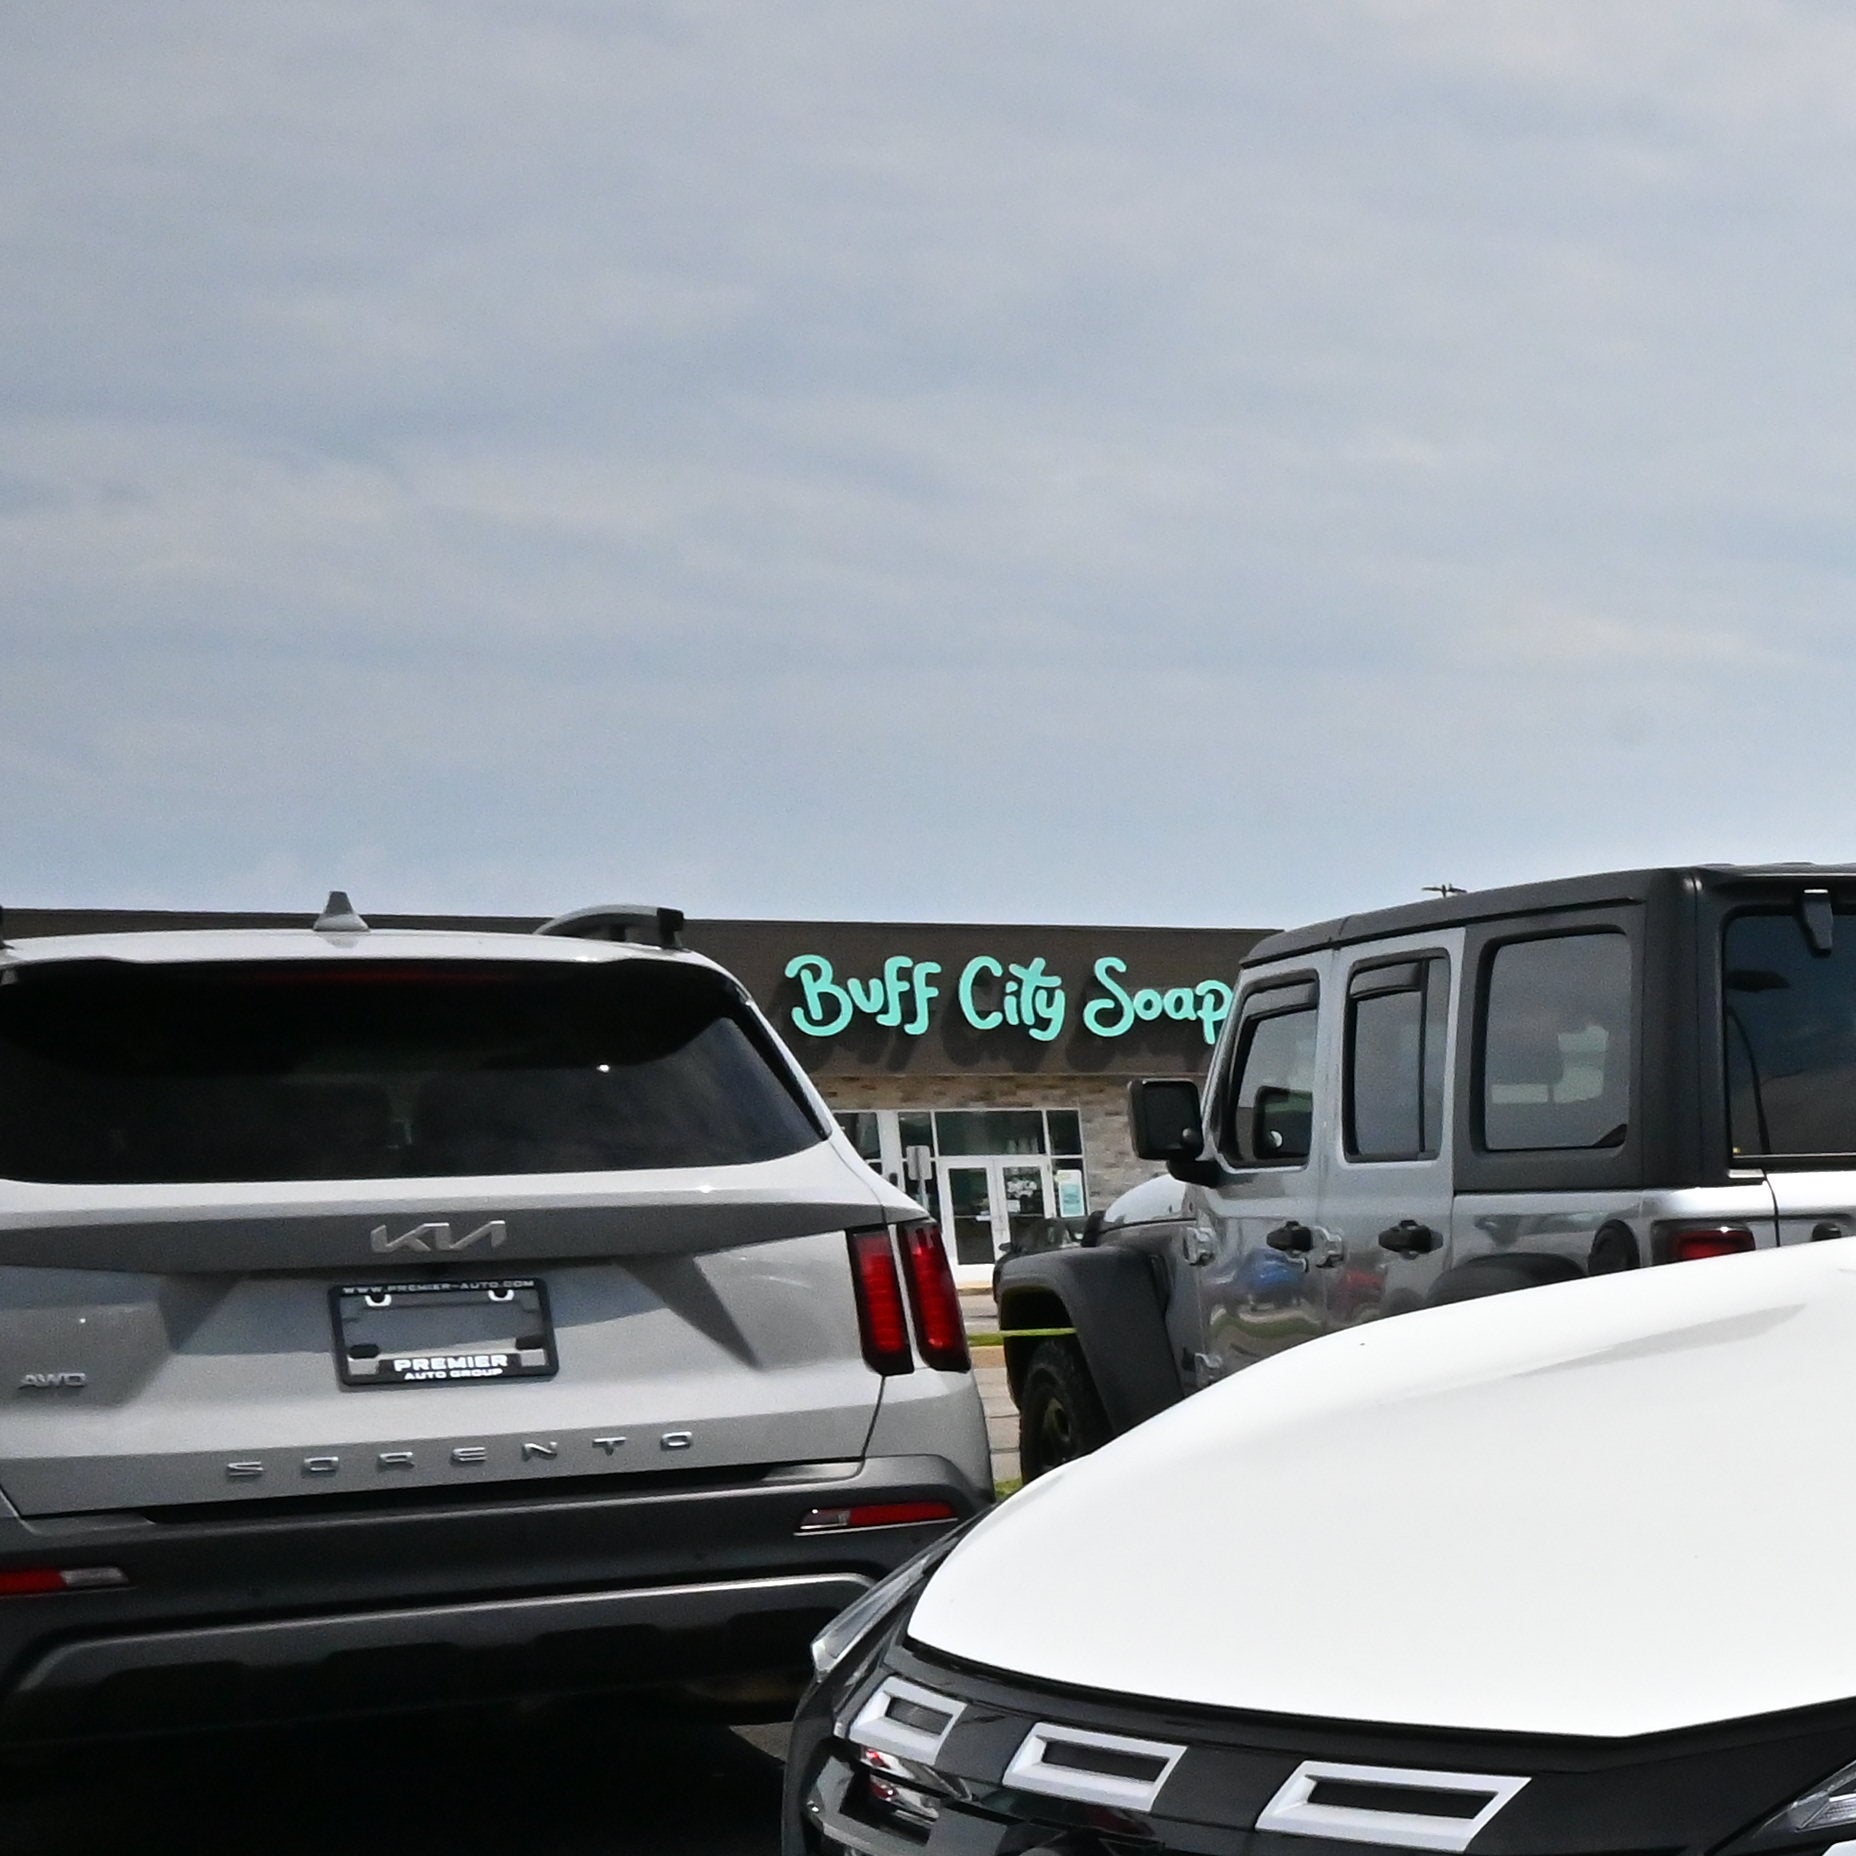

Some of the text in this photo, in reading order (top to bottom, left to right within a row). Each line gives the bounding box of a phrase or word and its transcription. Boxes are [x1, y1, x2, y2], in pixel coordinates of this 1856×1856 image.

[785, 954, 1234, 1045] Buff City Soap
[393, 1354, 508, 1372] PREMIER
[404, 1367, 504, 1381] AUTO GROUP
[226, 1430, 694, 1478] SORENTO
